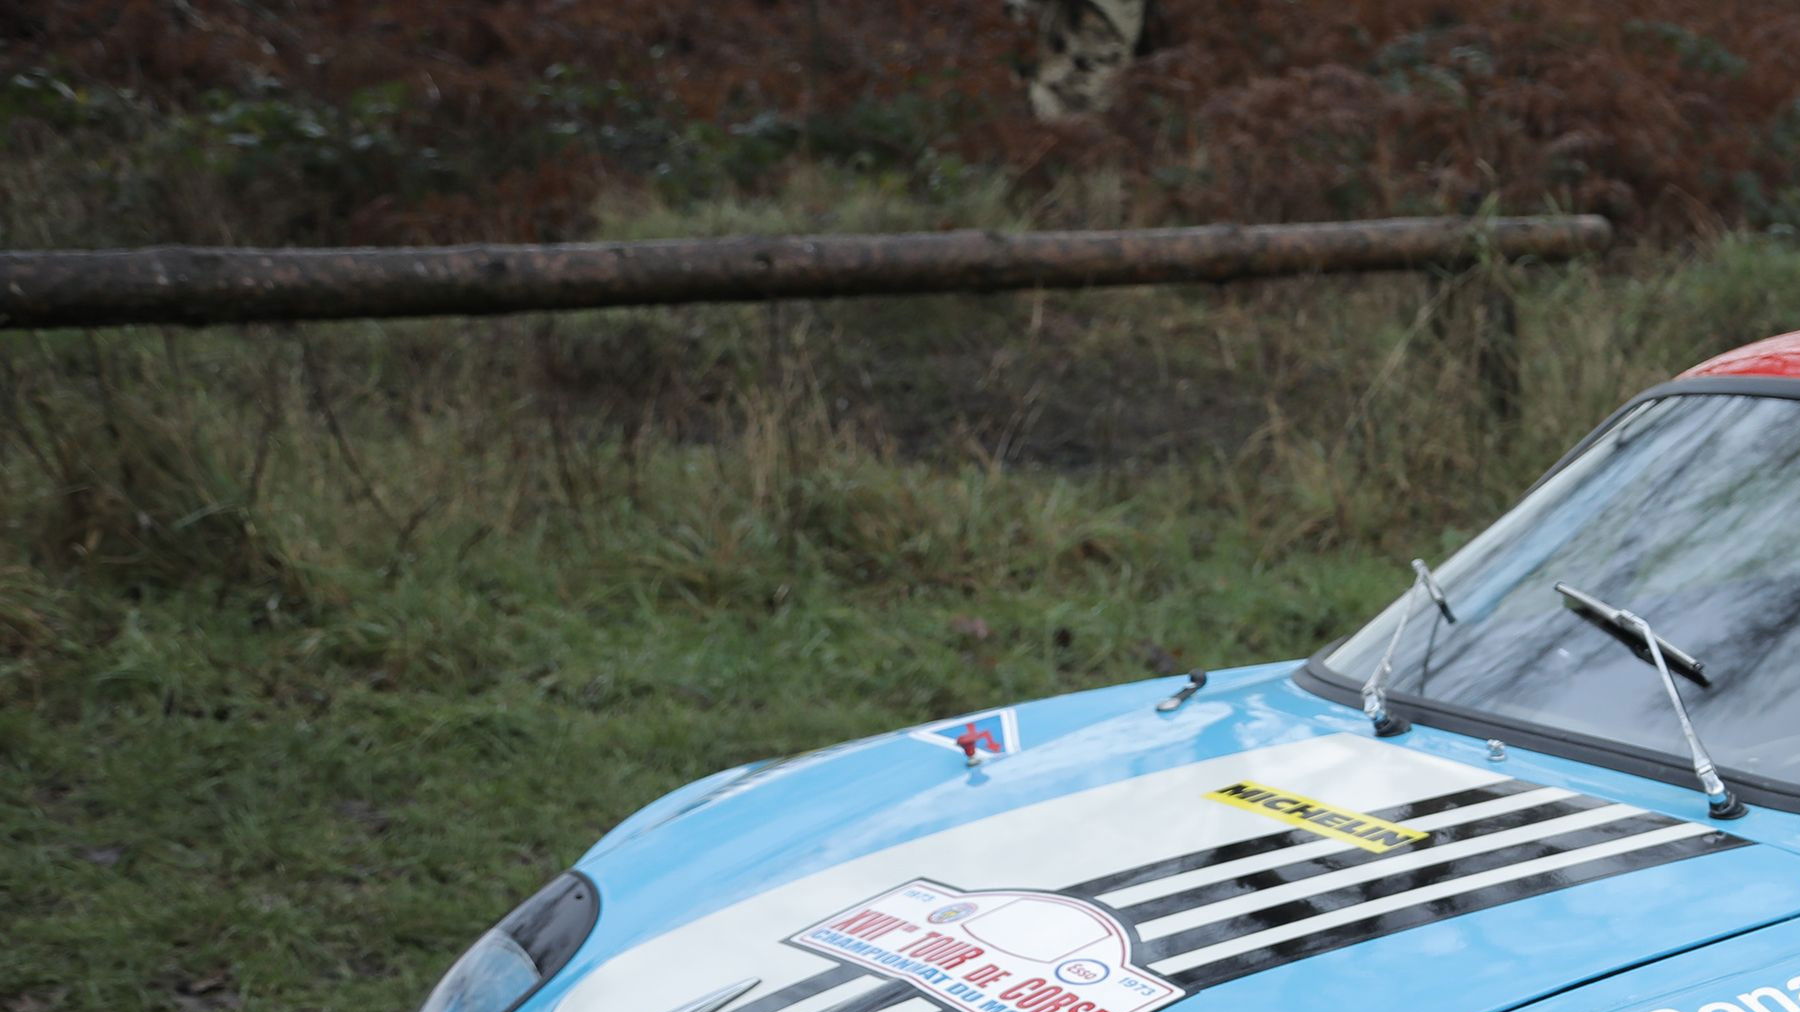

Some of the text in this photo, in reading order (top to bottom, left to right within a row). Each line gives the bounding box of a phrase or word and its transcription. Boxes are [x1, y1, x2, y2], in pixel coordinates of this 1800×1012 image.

[1216, 785, 1412, 848] MICHELIN
[811, 927, 953, 985] CHAMPIONNAT
[945, 982, 985, 1003] DU
[897, 931, 985, 971] TOUR
[962, 964, 1012, 989] DE
[1118, 976, 1157, 997] 1973
